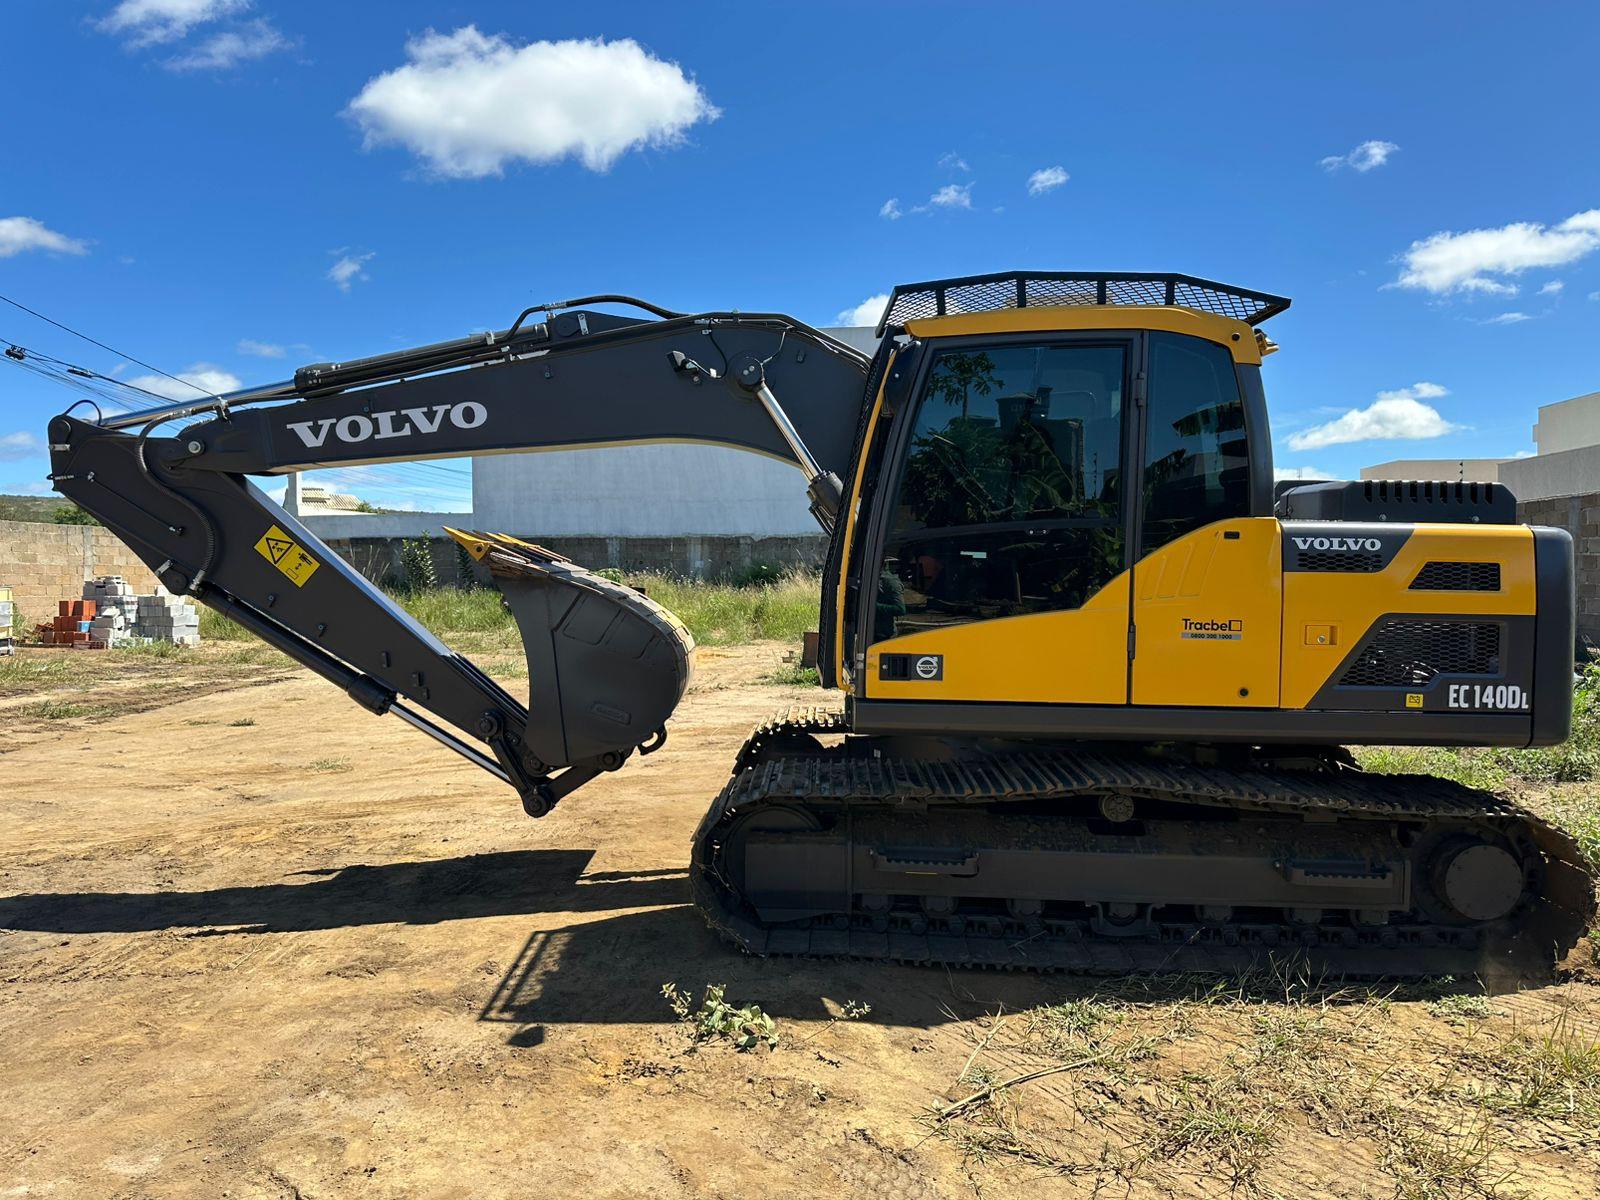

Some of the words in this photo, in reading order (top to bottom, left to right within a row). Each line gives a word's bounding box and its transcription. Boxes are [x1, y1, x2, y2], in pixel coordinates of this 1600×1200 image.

[286, 401, 488, 448] VOLVO
[1292, 537, 1382, 551] VOLVO
[1182, 618, 1232, 632] Tracbel
[1448, 684, 1470, 708] EC
